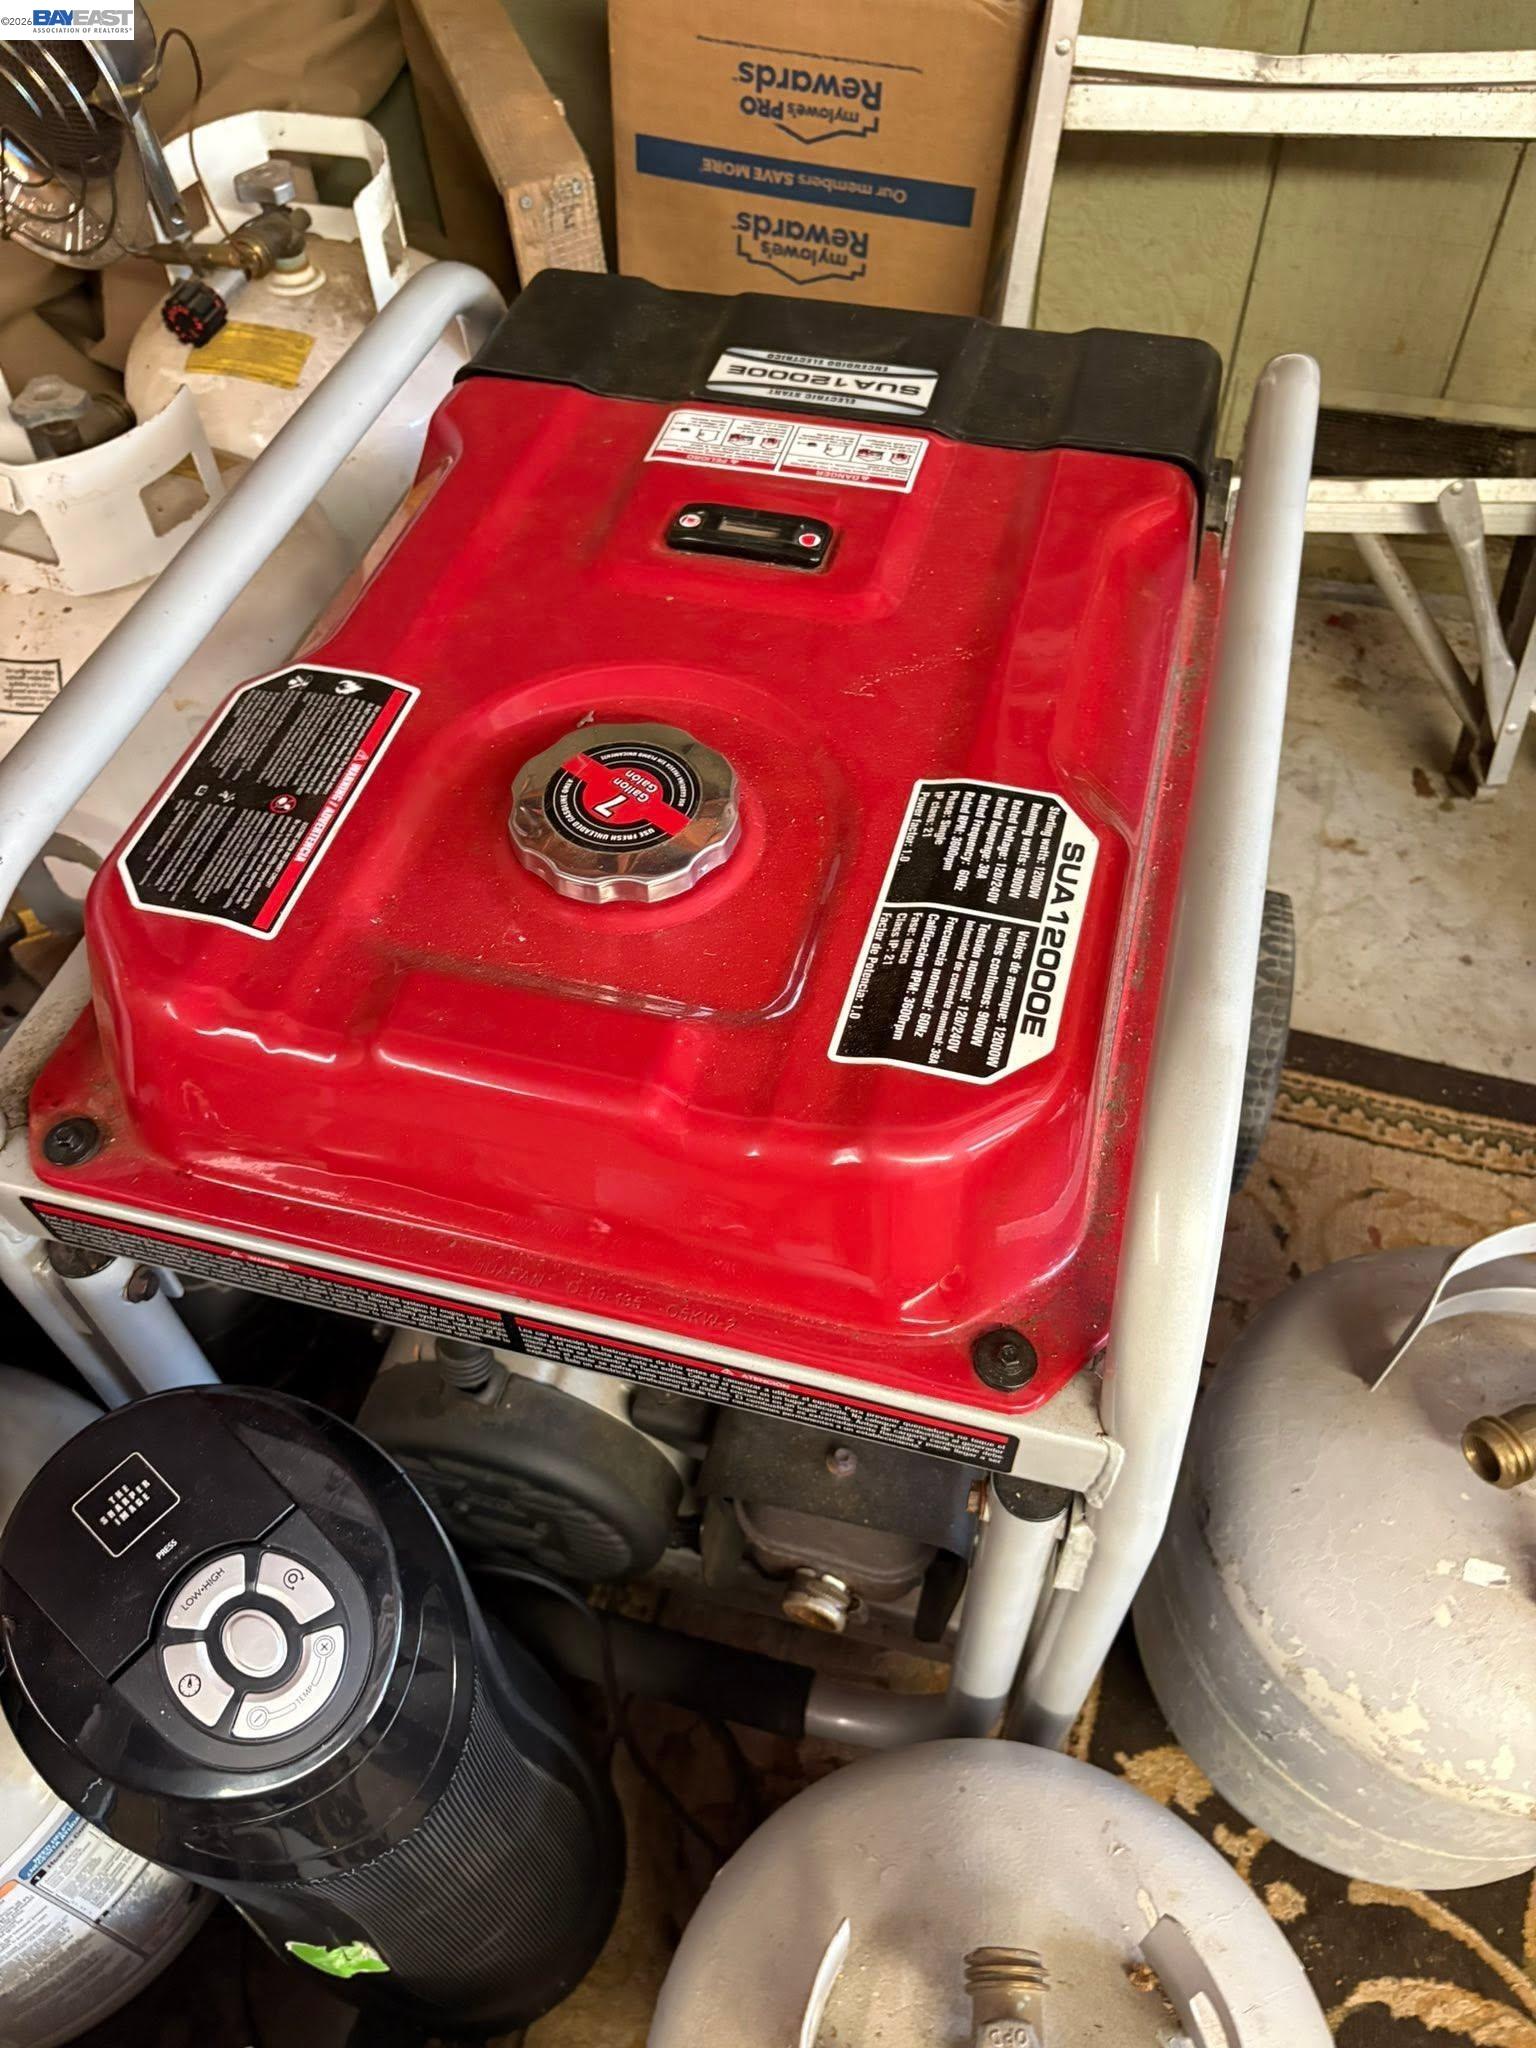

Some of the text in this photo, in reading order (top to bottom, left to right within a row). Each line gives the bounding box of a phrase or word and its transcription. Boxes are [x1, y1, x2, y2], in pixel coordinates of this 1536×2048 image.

[740, 94, 783, 120] PRO
[753, 165, 794, 186] SAVE
[798, 172, 871, 198] members
[875, 184, 906, 204] Our
[612, 777, 648, 803] Gallon
[625, 769, 658, 793] Galón
[561, 795, 575, 822] GASOLINE
[594, 795, 626, 818] 7
[899, 791, 930, 862] Power factor: 1.0
[921, 790, 945, 837] IP class: 21
[931, 790, 960, 845] Phase: Single
[572, 821, 609, 841] UNLEADED
[610, 833, 637, 841] FRESH
[639, 828, 655, 838] USE
[940, 791, 975, 871] Rated RPM: 3600rpm
[953, 793, 991, 891] Rated Frequency: 60Hz
[974, 796, 1008, 879] Rated Amperage: 38A
[985, 799, 1024, 904] Rated Voltage: 120/240V
[1007, 802, 1043, 898] Running watts: 9000W
[1026, 805, 1061, 899] Starting watts: 12000W
[881, 912, 907, 965] Class IP: 21
[906, 911, 923, 936] Fase:
[1020, 841, 1085, 1038] SUA12000E
[848, 912, 892, 1019] Factor de Potencia: 1.0
[905, 969, 923, 994] RPM:
[913, 916, 958, 1038] Frecuencia nominal: 60Hz
[958, 960, 981, 1002] nominal:
[969, 926, 1011, 1046] Vatios continuos: 9000W
[927, 920, 975, 1064] Intensidad de corriente nominal: 38A
[984, 930, 1030, 1067] Vatios de arranque: 12000W
[889, 996, 915, 1040] 3600rpm
[945, 1005, 969, 1052] 120/240V
[99, 1479, 152, 1526] SHARPER
[108, 1484, 130, 1504] THE
[113, 1493, 152, 1527] IMAGE
[156, 1539, 178, 1560] PRESS
